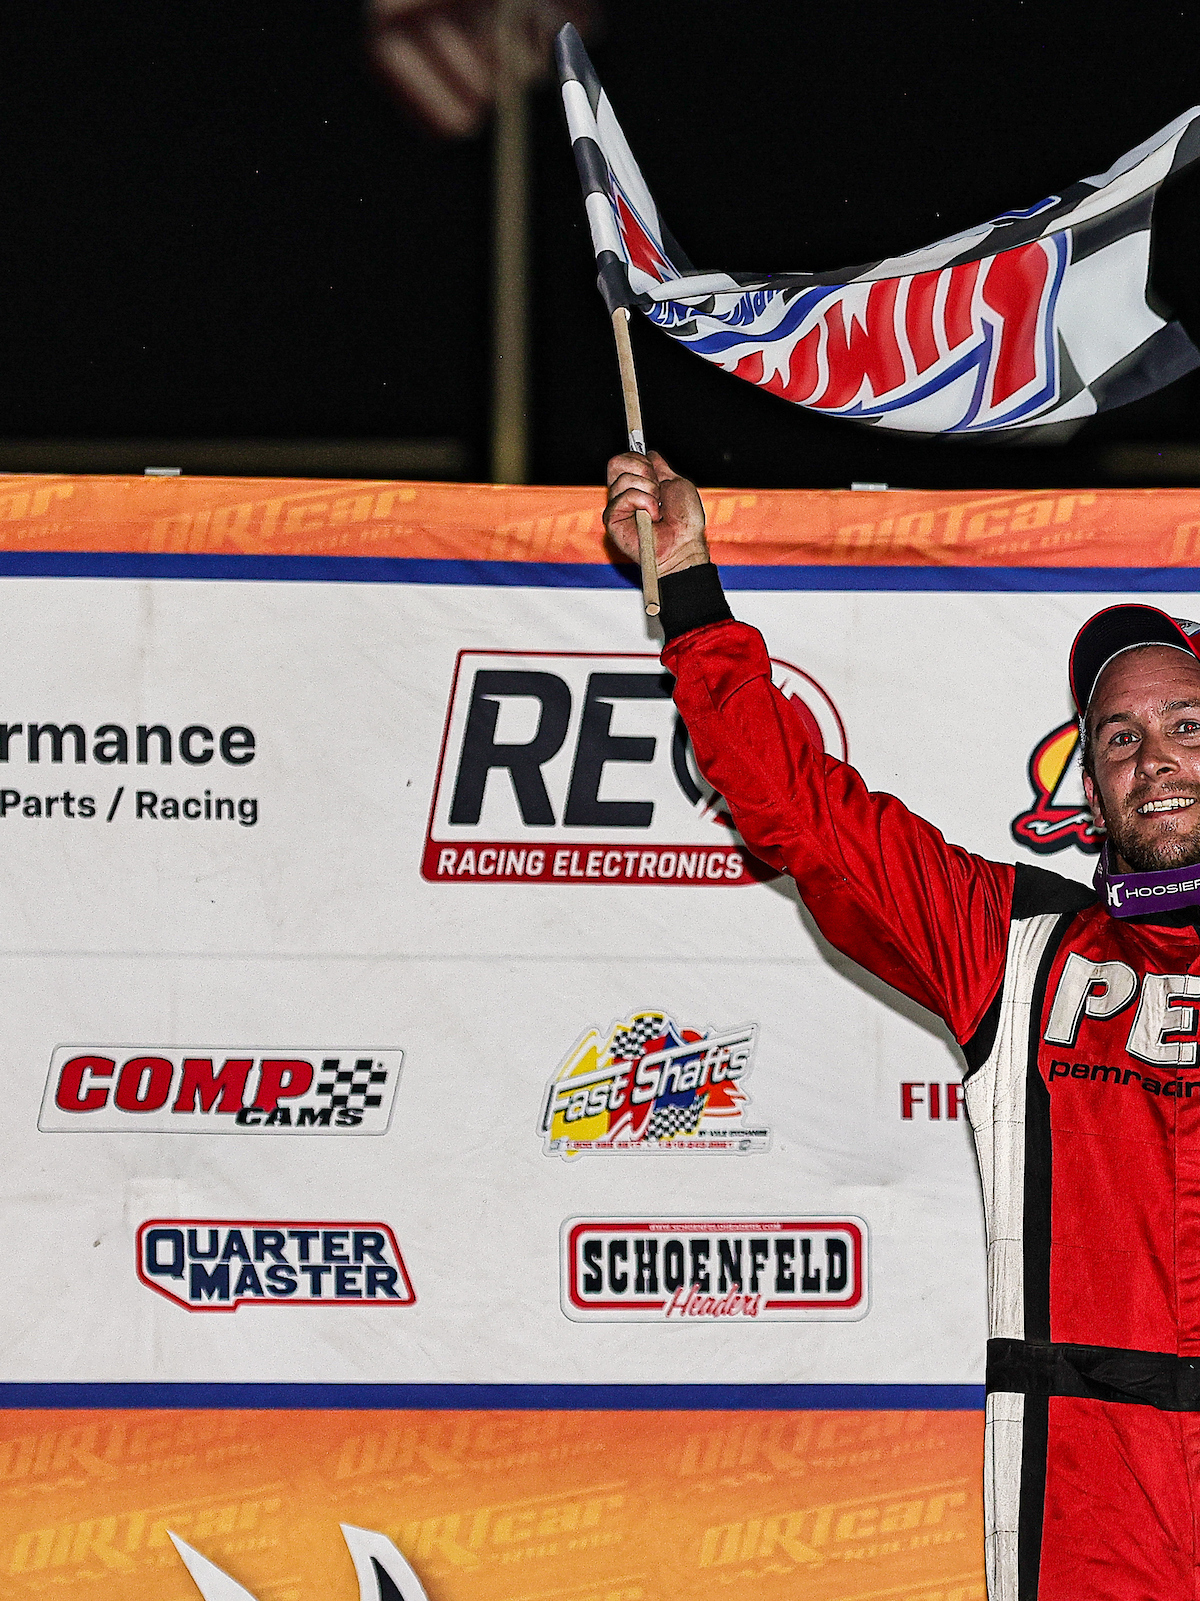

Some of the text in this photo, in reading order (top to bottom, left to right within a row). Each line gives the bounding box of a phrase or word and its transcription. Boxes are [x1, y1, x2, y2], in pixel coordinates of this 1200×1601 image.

[0, 723, 256, 766] rmance
[0, 789, 96, 819] Parts
[135, 789, 259, 827] Racing
[437, 849, 744, 881] RACING ELECTRONICS
[55, 1055, 315, 1114] COMP
[542, 1026, 755, 1132] Fast Shafts
[235, 1107, 364, 1127] CAMS
[145, 1228, 387, 1279] QUARTER
[582, 1238, 849, 1295] SCHOENFELD
[189, 1262, 403, 1300] MASTER
[664, 1284, 763, 1319] Headers
